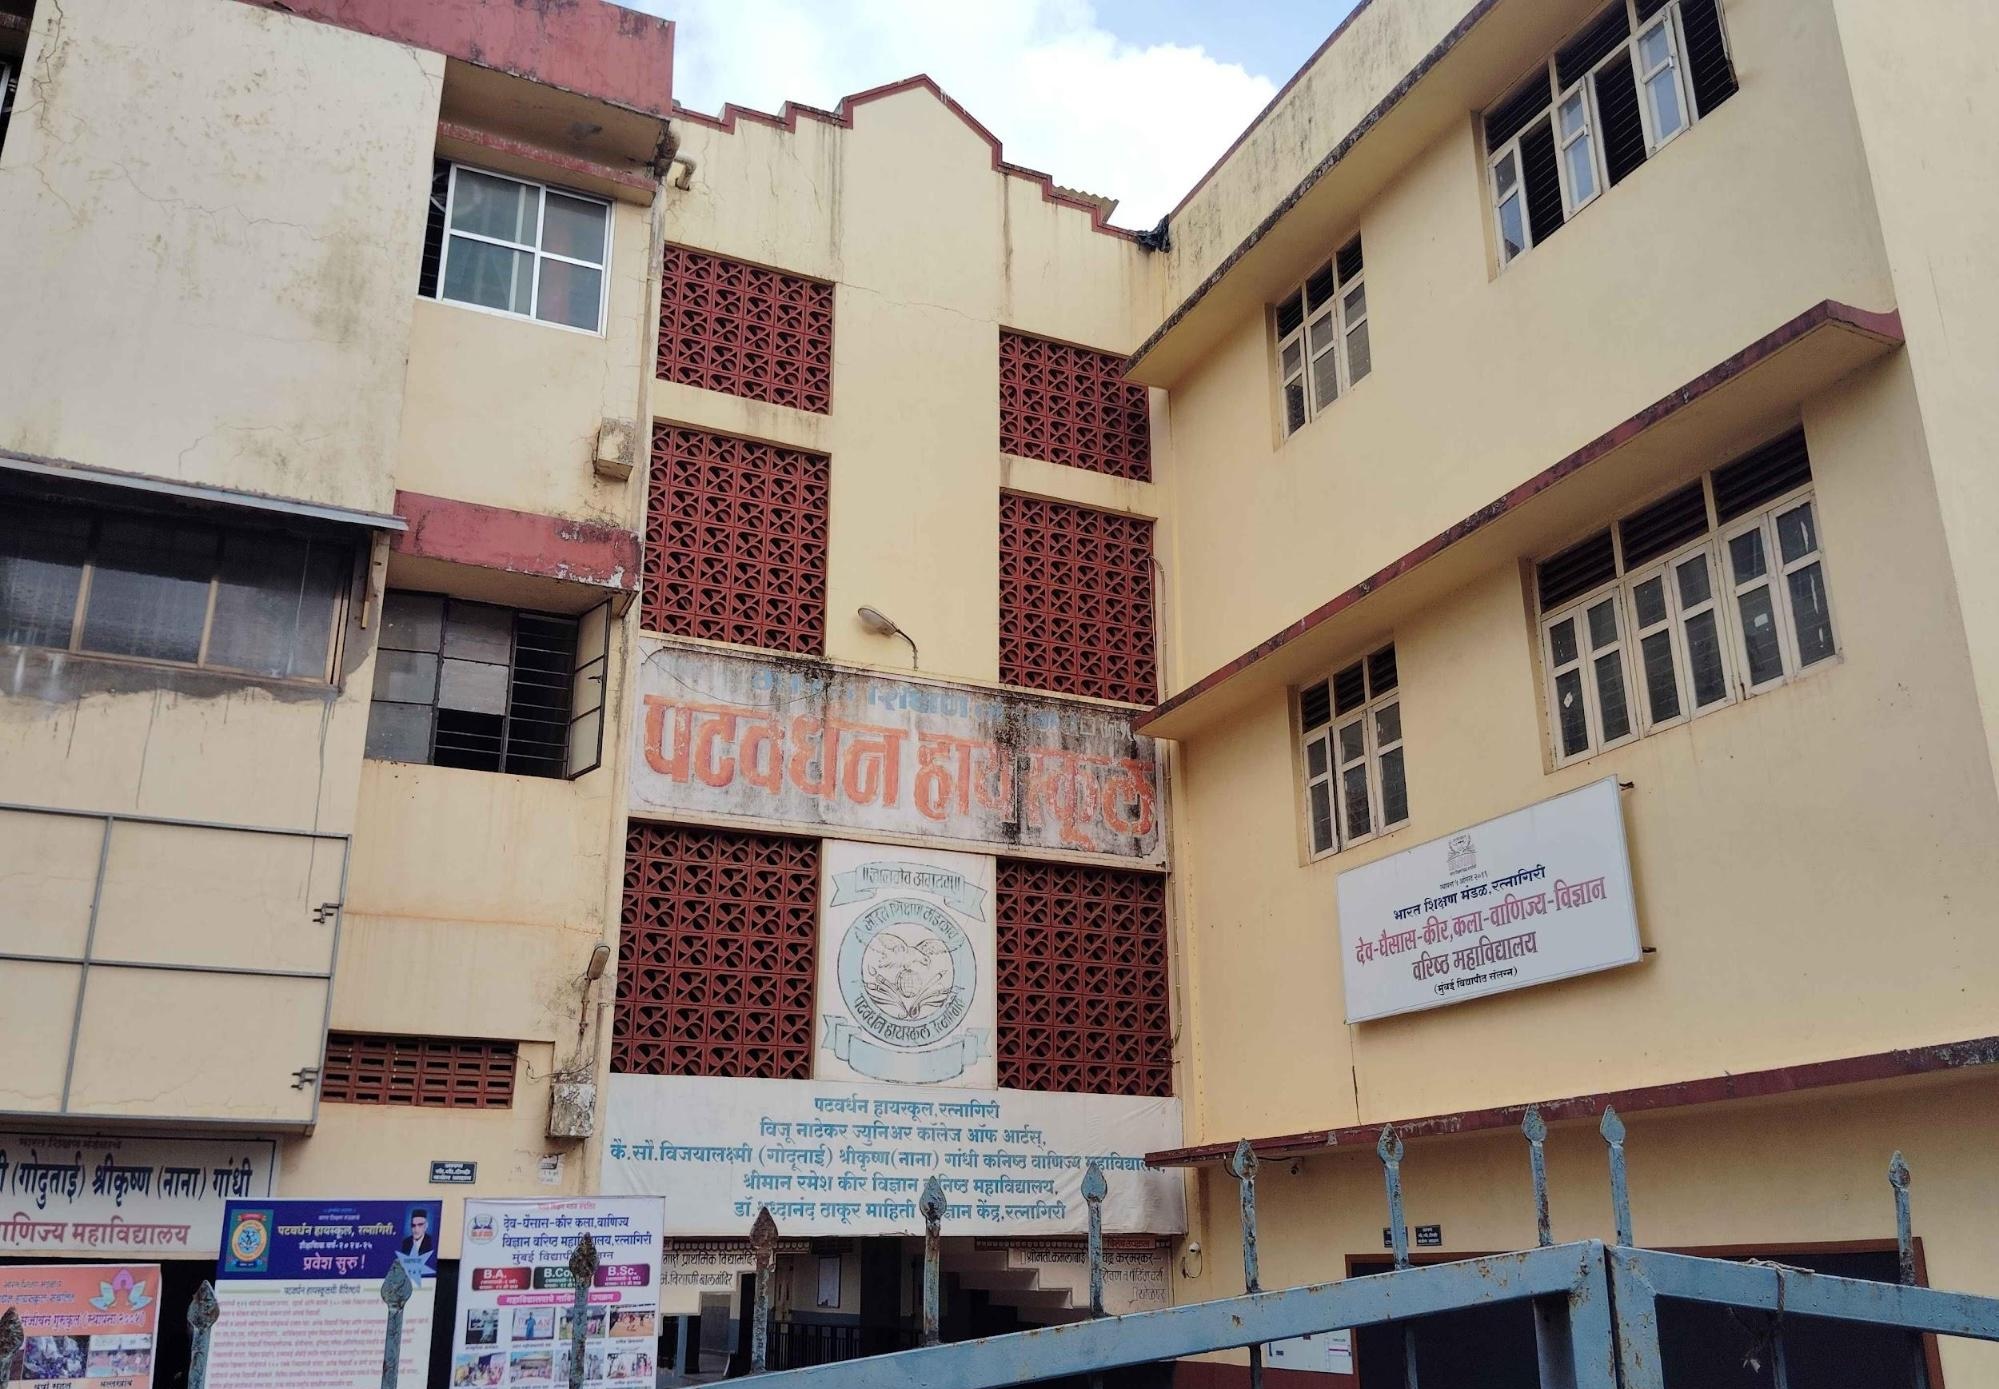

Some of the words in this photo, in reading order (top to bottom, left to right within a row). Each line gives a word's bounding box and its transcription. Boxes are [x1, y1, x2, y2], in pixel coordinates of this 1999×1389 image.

[1393, 902, 1421, 920] भारत
[1424, 894, 1457, 916] शिक्षण
[1412, 950, 1451, 982] वरिष्ठ
[1453, 931, 1538, 971] महाविद्यालय
[815, 1093, 869, 1114] पटवर्धन
[760, 1116, 795, 1144] विजू
[796, 1117, 848, 1140] नाटेकर
[853, 1120, 913, 1146] ज्युनिअर
[917, 1122, 962, 1143] कॉलेज
[968, 1123, 998, 1143] ऑफ
[945, 1147, 978, 1169] गांधी
[983, 1149, 1027, 1170] कनिष्ठ
[1032, 1151, 1080, 1170] वाणिज्य
[92, 1153, 153, 1207] श्रीकृष्ण
[157, 1164, 207, 1200] (नाना)
[212, 1156, 253, 1198] गांधी
[743, 1170, 791, 1192] श्रीमान
[797, 1171, 832, 1192] रमेश
[838, 1170, 868, 1192] कीर
[872, 1172, 919, 1193] विज्ञान
[923, 1173, 969, 1194] निष्ठ
[820, 1202, 860, 1225] ठाकूर
[866, 1199, 916, 1220] माहिती
[72, 1215, 191, 1246] महाविद्यालय
[278, 1222, 312, 1236] पटवर्धन
[502, 1233, 530, 1247] विज्ञान
[533, 1233, 558, 1247] वरिष्ठ
[303, 1252, 332, 1271] प्रवेश
[512, 1250, 534, 1264] मुंबई
[539, 1250, 572, 1262] विद्यापी
[483, 1269, 507, 1279] B.A.
[543, 1267, 574, 1278] B.Co
[608, 1265, 638, 1276] B.Sc.
